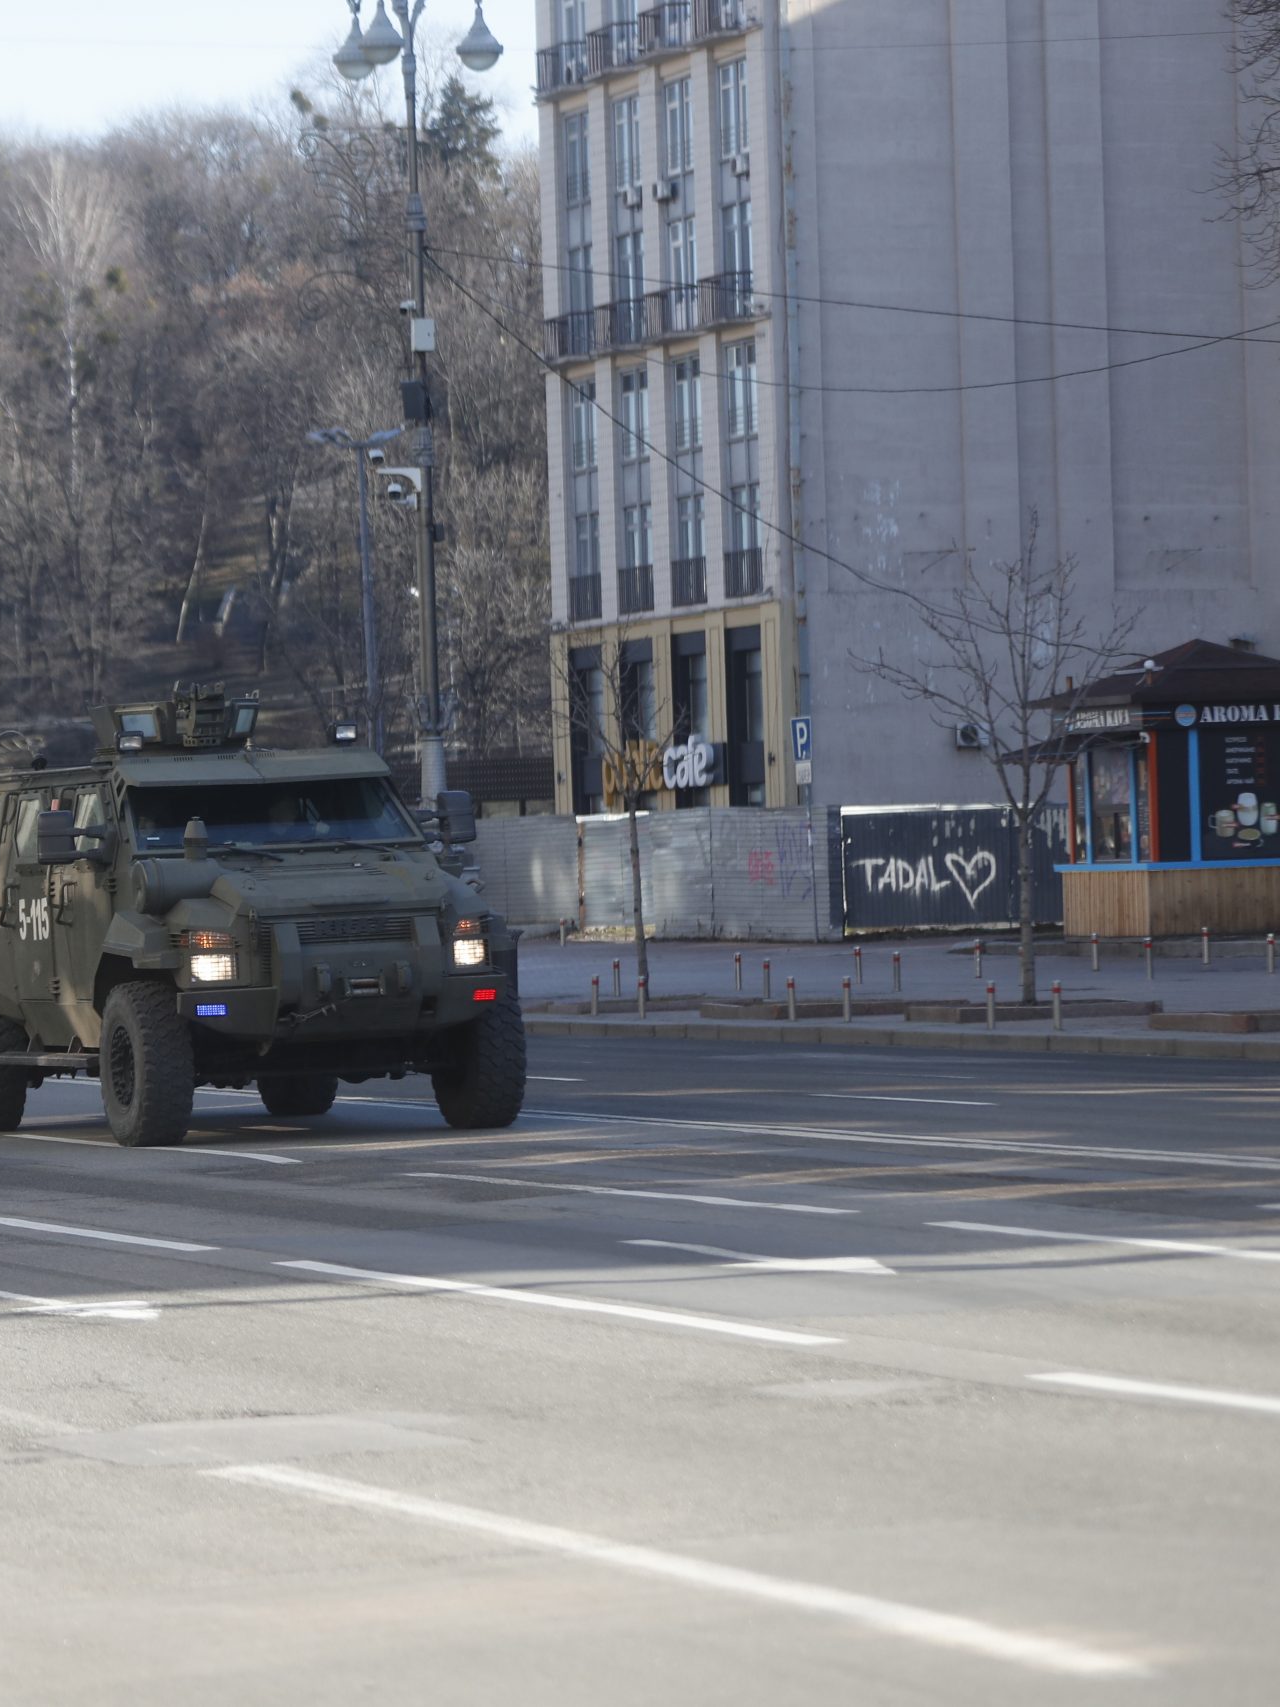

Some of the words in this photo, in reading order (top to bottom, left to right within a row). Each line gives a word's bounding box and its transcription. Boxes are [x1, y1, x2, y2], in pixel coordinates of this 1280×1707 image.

[1200, 705, 1269, 722] AROMA
[796, 722, 807, 758] P
[663, 735, 713, 789] cafe
[851, 856, 951, 895] TADAL
[19, 897, 50, 940] 5-115
